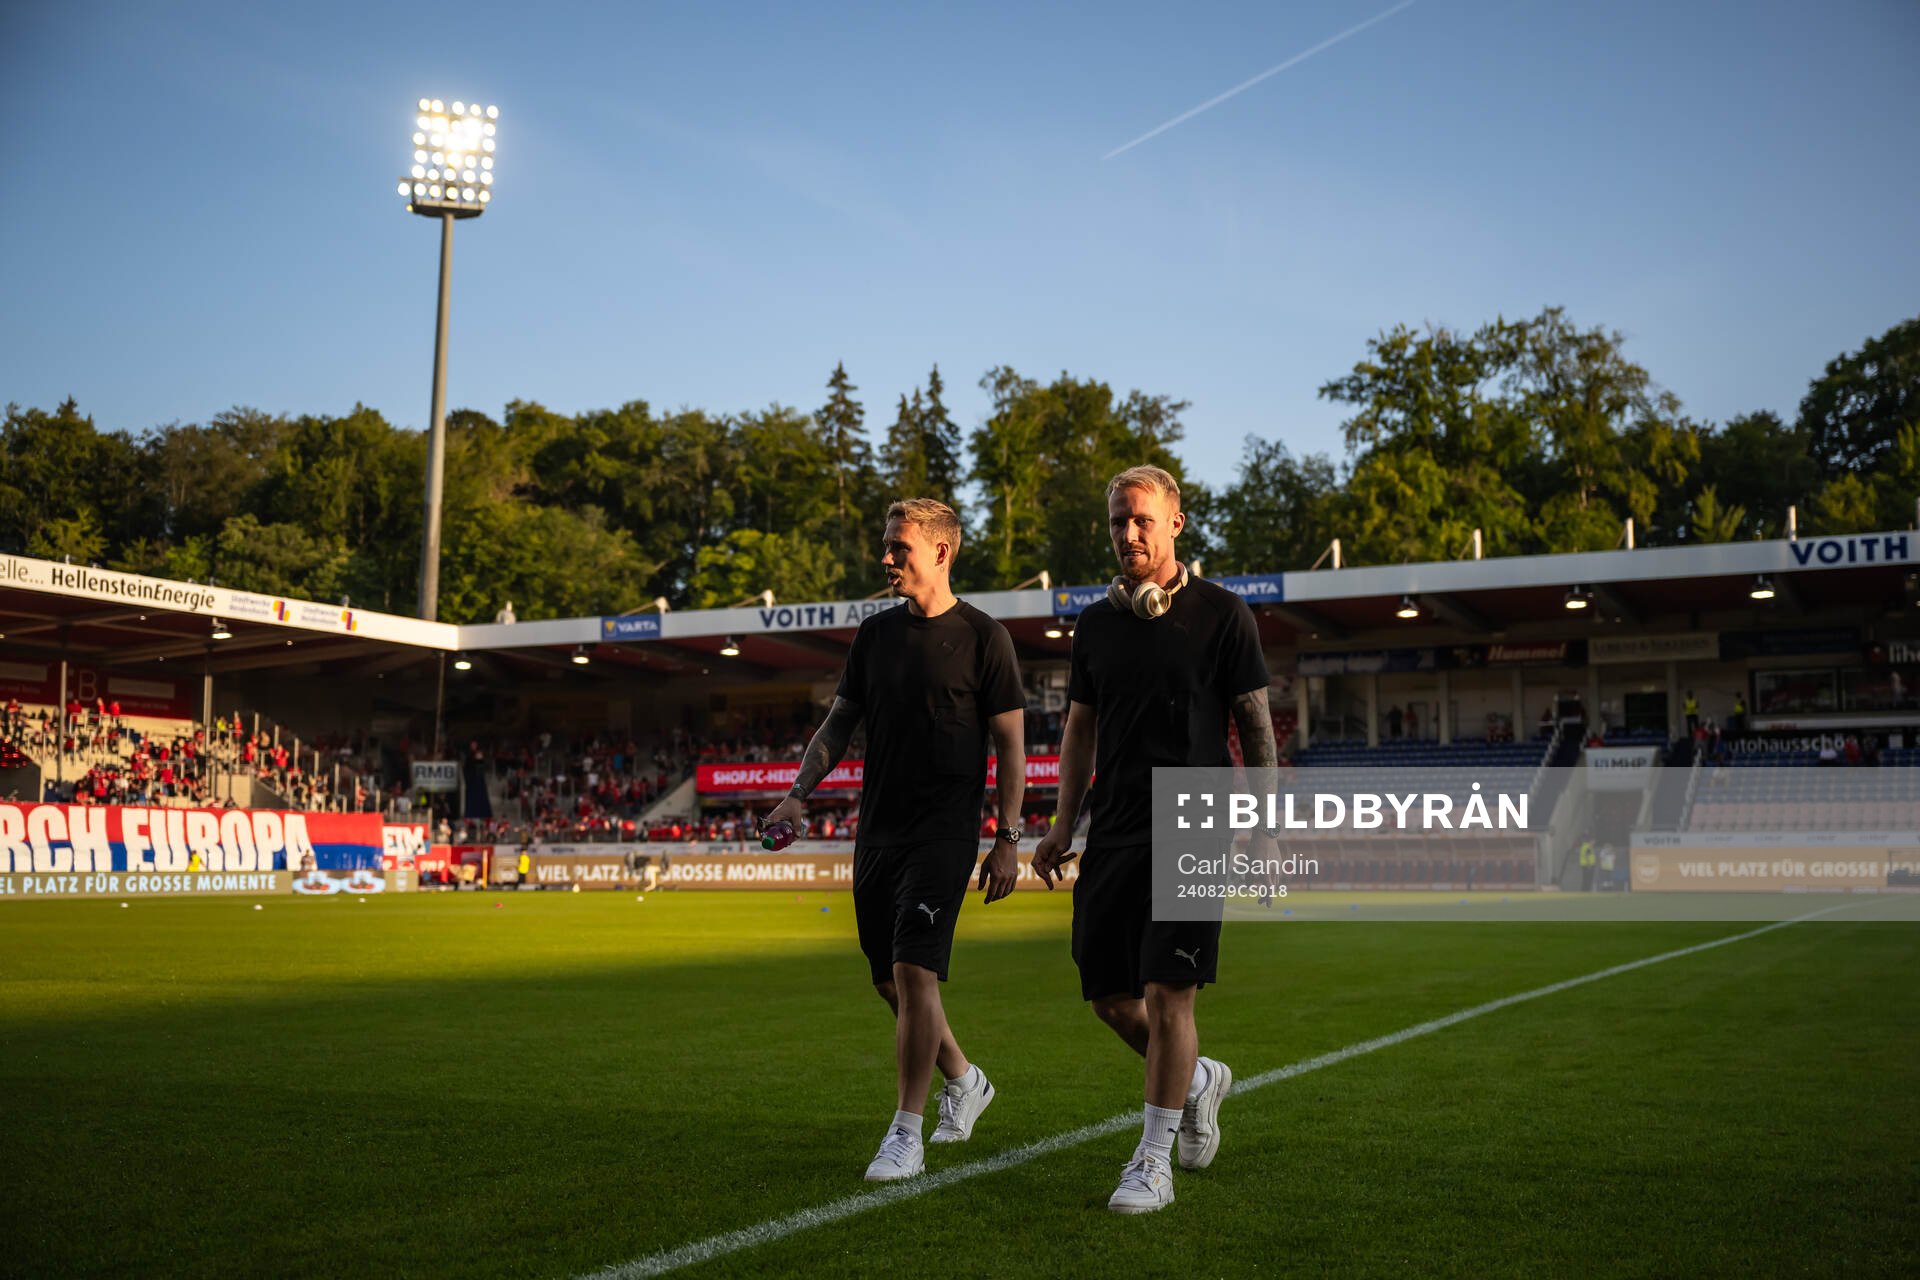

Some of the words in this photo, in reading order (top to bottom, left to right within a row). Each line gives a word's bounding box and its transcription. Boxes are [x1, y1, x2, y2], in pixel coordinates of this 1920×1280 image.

[1790, 536, 1908, 565] VOITH
[52, 567, 215, 611] HellensteinEnergie
[1072, 593, 1108, 606] VAR
[617, 620, 658, 633] VARTA
[759, 606, 835, 628] VOITH
[415, 765, 454, 778] RMB
[122, 806, 317, 872] EUROPA
[536, 864, 573, 881] VIEL
[576, 864, 619, 881] PLATZ
[726, 863, 816, 881] MOMENTE
[834, 862, 853, 880] IH
[1678, 861, 1714, 878] VIEL
[1718, 861, 1768, 878] PLATZ
[1772, 857, 1806, 877] FÜR
[1809, 861, 1879, 877] GROSSE
[23, 876, 78, 893] PLATZ
[85, 873, 122, 892] FÜR
[126, 874, 192, 892] GROSSE
[196, 874, 276, 891] MOMENTE
